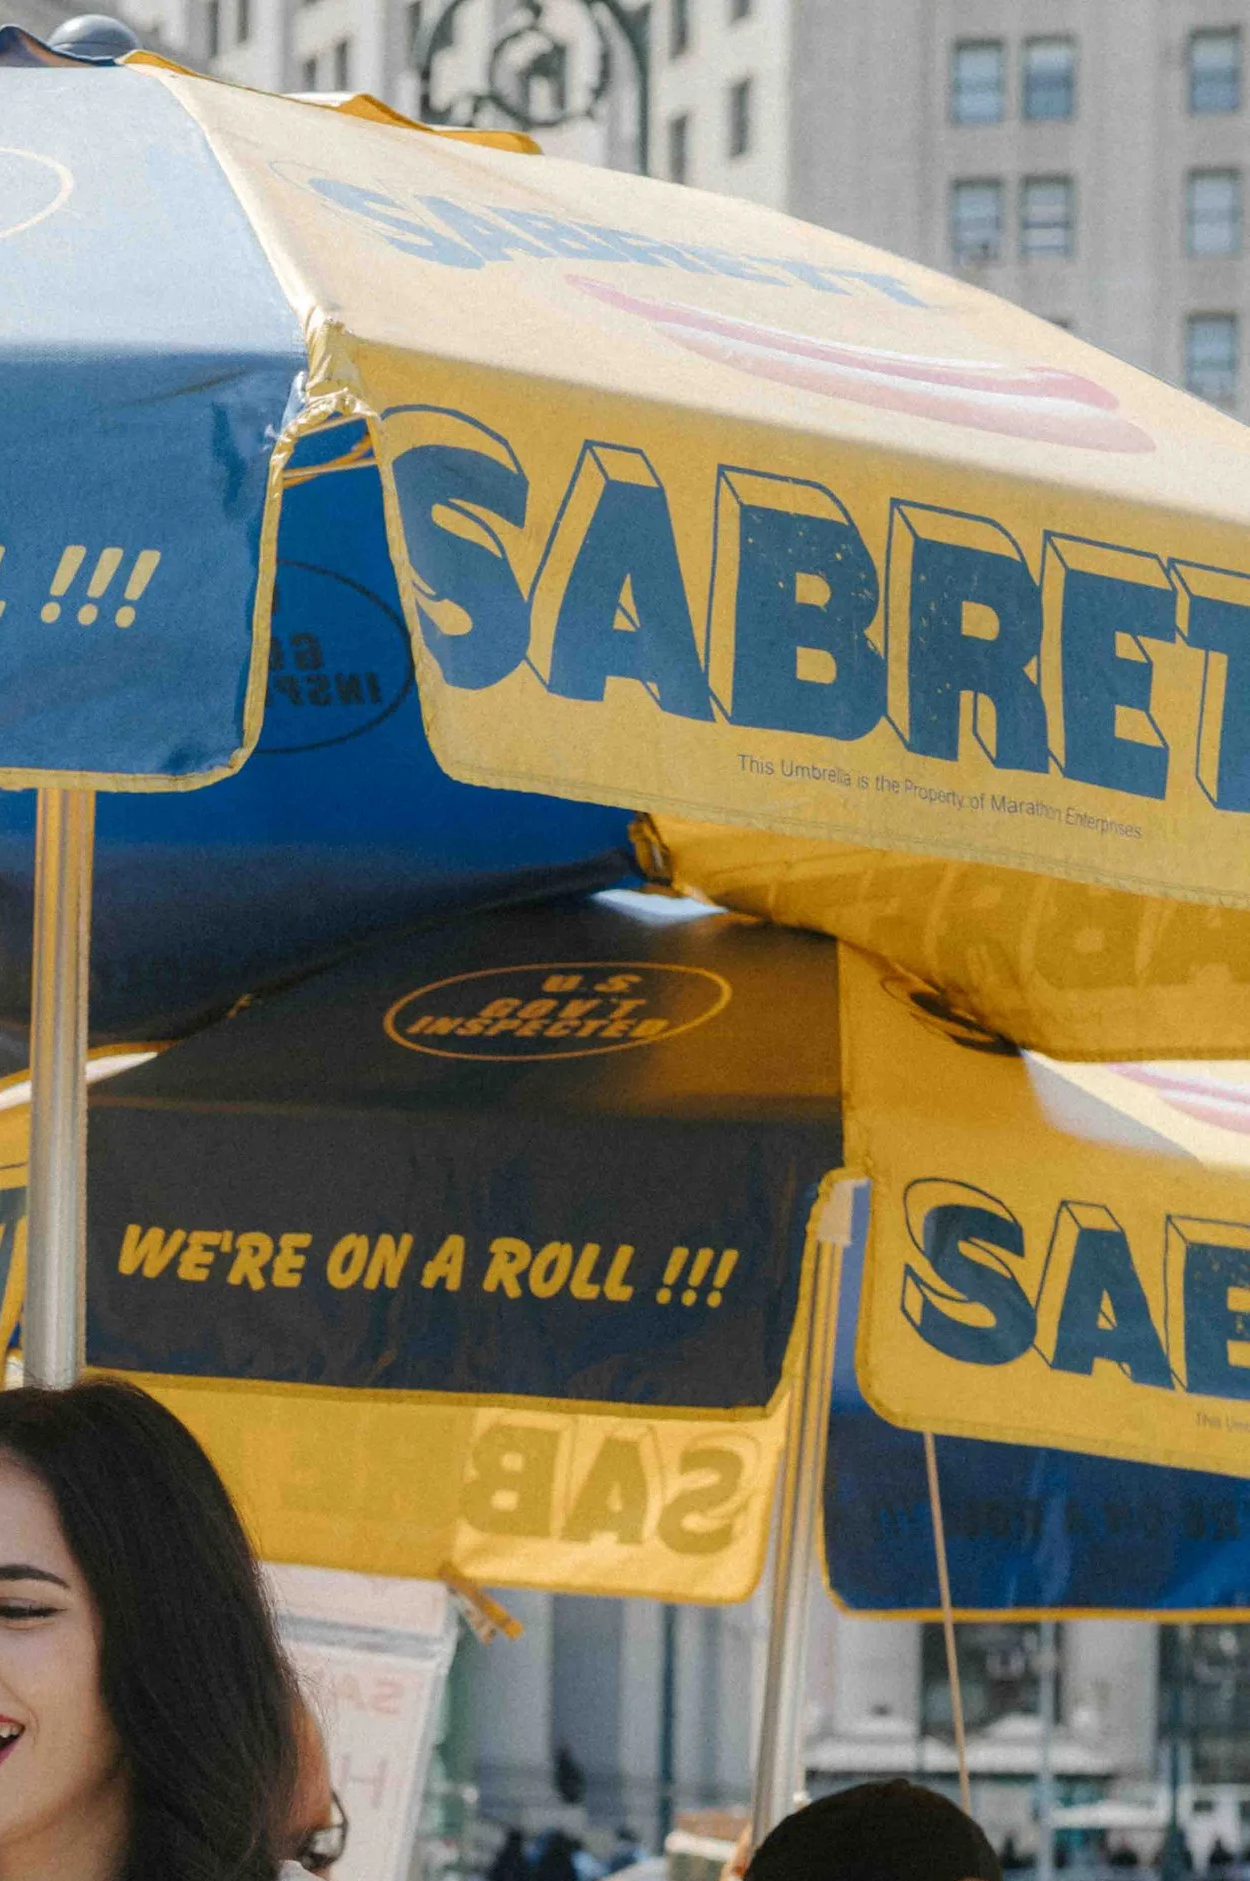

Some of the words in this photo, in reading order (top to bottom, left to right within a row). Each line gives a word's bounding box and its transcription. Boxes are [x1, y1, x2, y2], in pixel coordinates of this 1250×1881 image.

[307, 177, 932, 308] SABRETT
[40, 544, 162, 629] !!!
[737, 753, 775, 776] This
[781, 758, 851, 788] Umbrella
[857, 773, 871, 790] is
[875, 774, 901, 795] the
[904, 777, 964, 812] Property
[969, 792, 986, 811] of
[1065, 806, 1143, 840] Enterprises
[406, 1014, 670, 1039] INSPECTED
[117, 1223, 313, 1291] WE'RE
[326, 1232, 414, 1291] ON
[420, 1233, 466, 1292] A
[482, 1236, 635, 1302] ROLL
[655, 1246, 740, 1309] !!!
